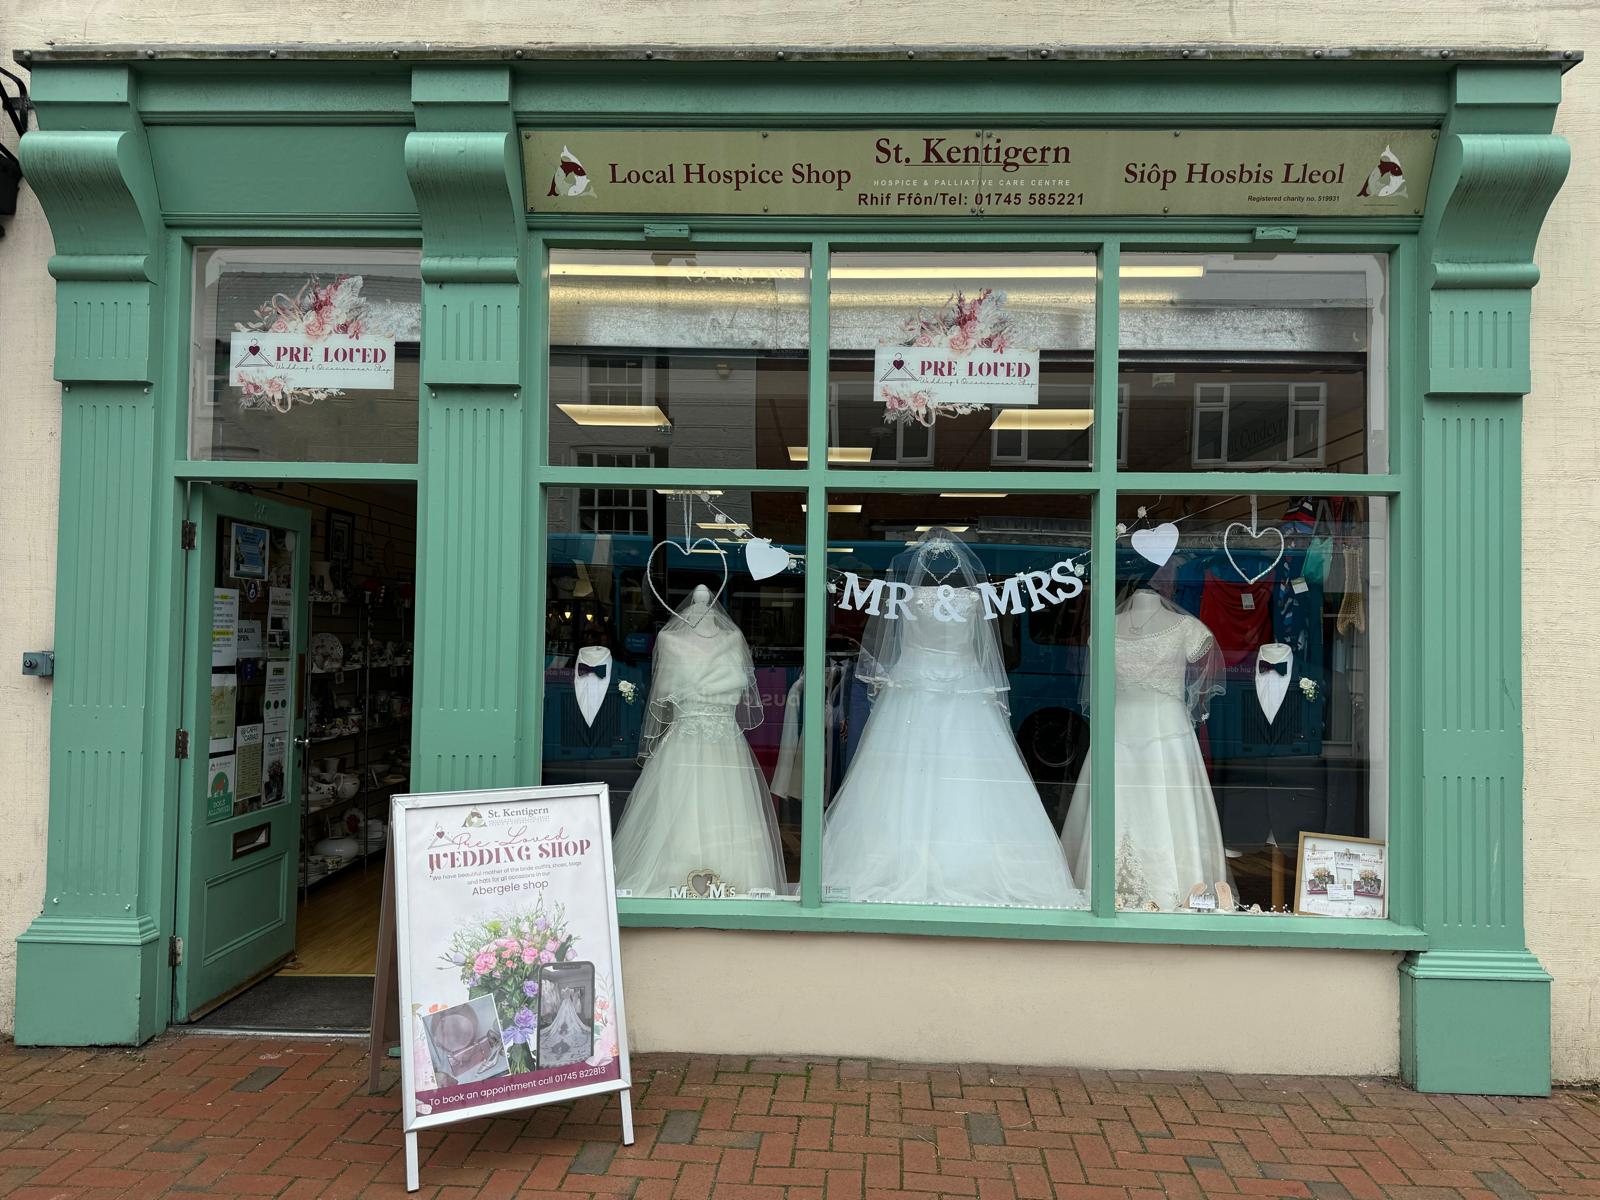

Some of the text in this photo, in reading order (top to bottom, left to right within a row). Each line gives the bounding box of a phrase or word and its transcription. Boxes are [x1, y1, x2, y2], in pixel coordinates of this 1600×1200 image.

[876, 138, 1071, 172] St. Kentigern
[609, 164, 851, 191] Local Hospice Shop
[873, 179, 918, 187] HOSPICE
[934, 179, 993, 187] PALLIATIVE
[999, 179, 1025, 187] CARE
[1031, 179, 1071, 187] CENTRE
[1124, 163, 1345, 191] Siôp Hosbis Lleol
[858, 193, 1085, 206] Rhif Ffôn/Tel: 01745 585221
[1283, 195, 1304, 203] charity
[276, 346, 387, 364] PRE LOVED
[920, 361, 1031, 378] PRE LOVED
[838, 559, 1084, 622] MR & MRS
[488, 806, 549, 819] St. Kentigern
[428, 839, 591, 874] WEDDING SHOP
[472, 879, 549, 896] Abergele shop
[429, 1066, 606, 1107] To book an appointment call 01745 822813
